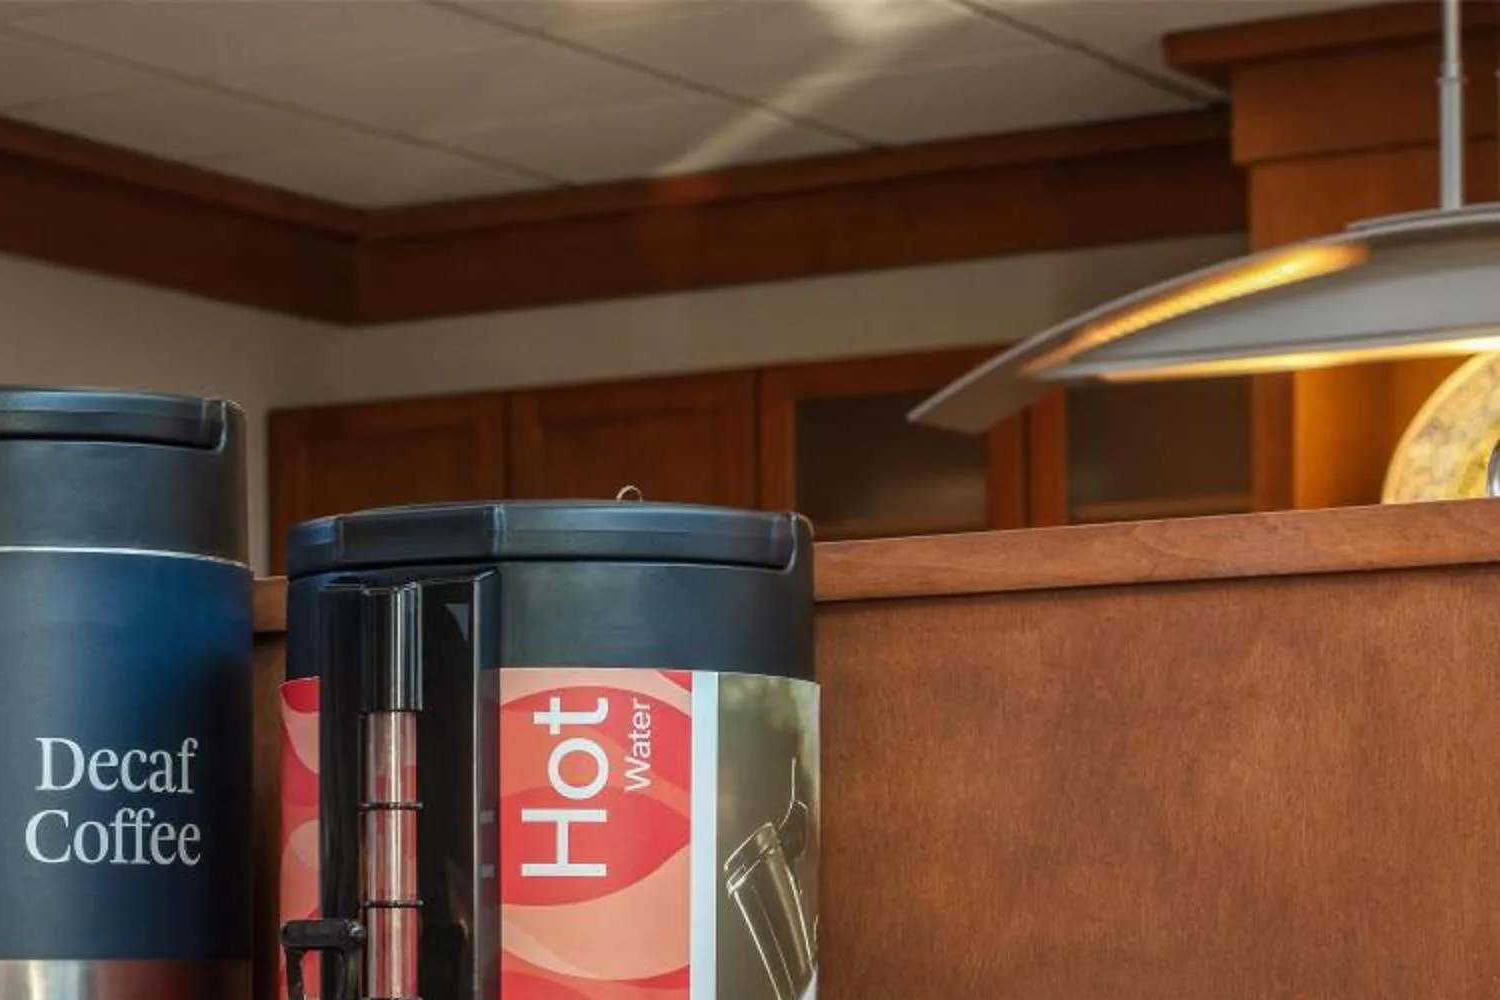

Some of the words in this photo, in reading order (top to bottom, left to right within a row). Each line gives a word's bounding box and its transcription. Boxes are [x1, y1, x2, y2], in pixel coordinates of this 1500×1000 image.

[34, 736, 199, 796] Decaf
[623, 697, 652, 793] Water
[520, 696, 610, 878] Hot
[24, 807, 202, 868] Coffee
